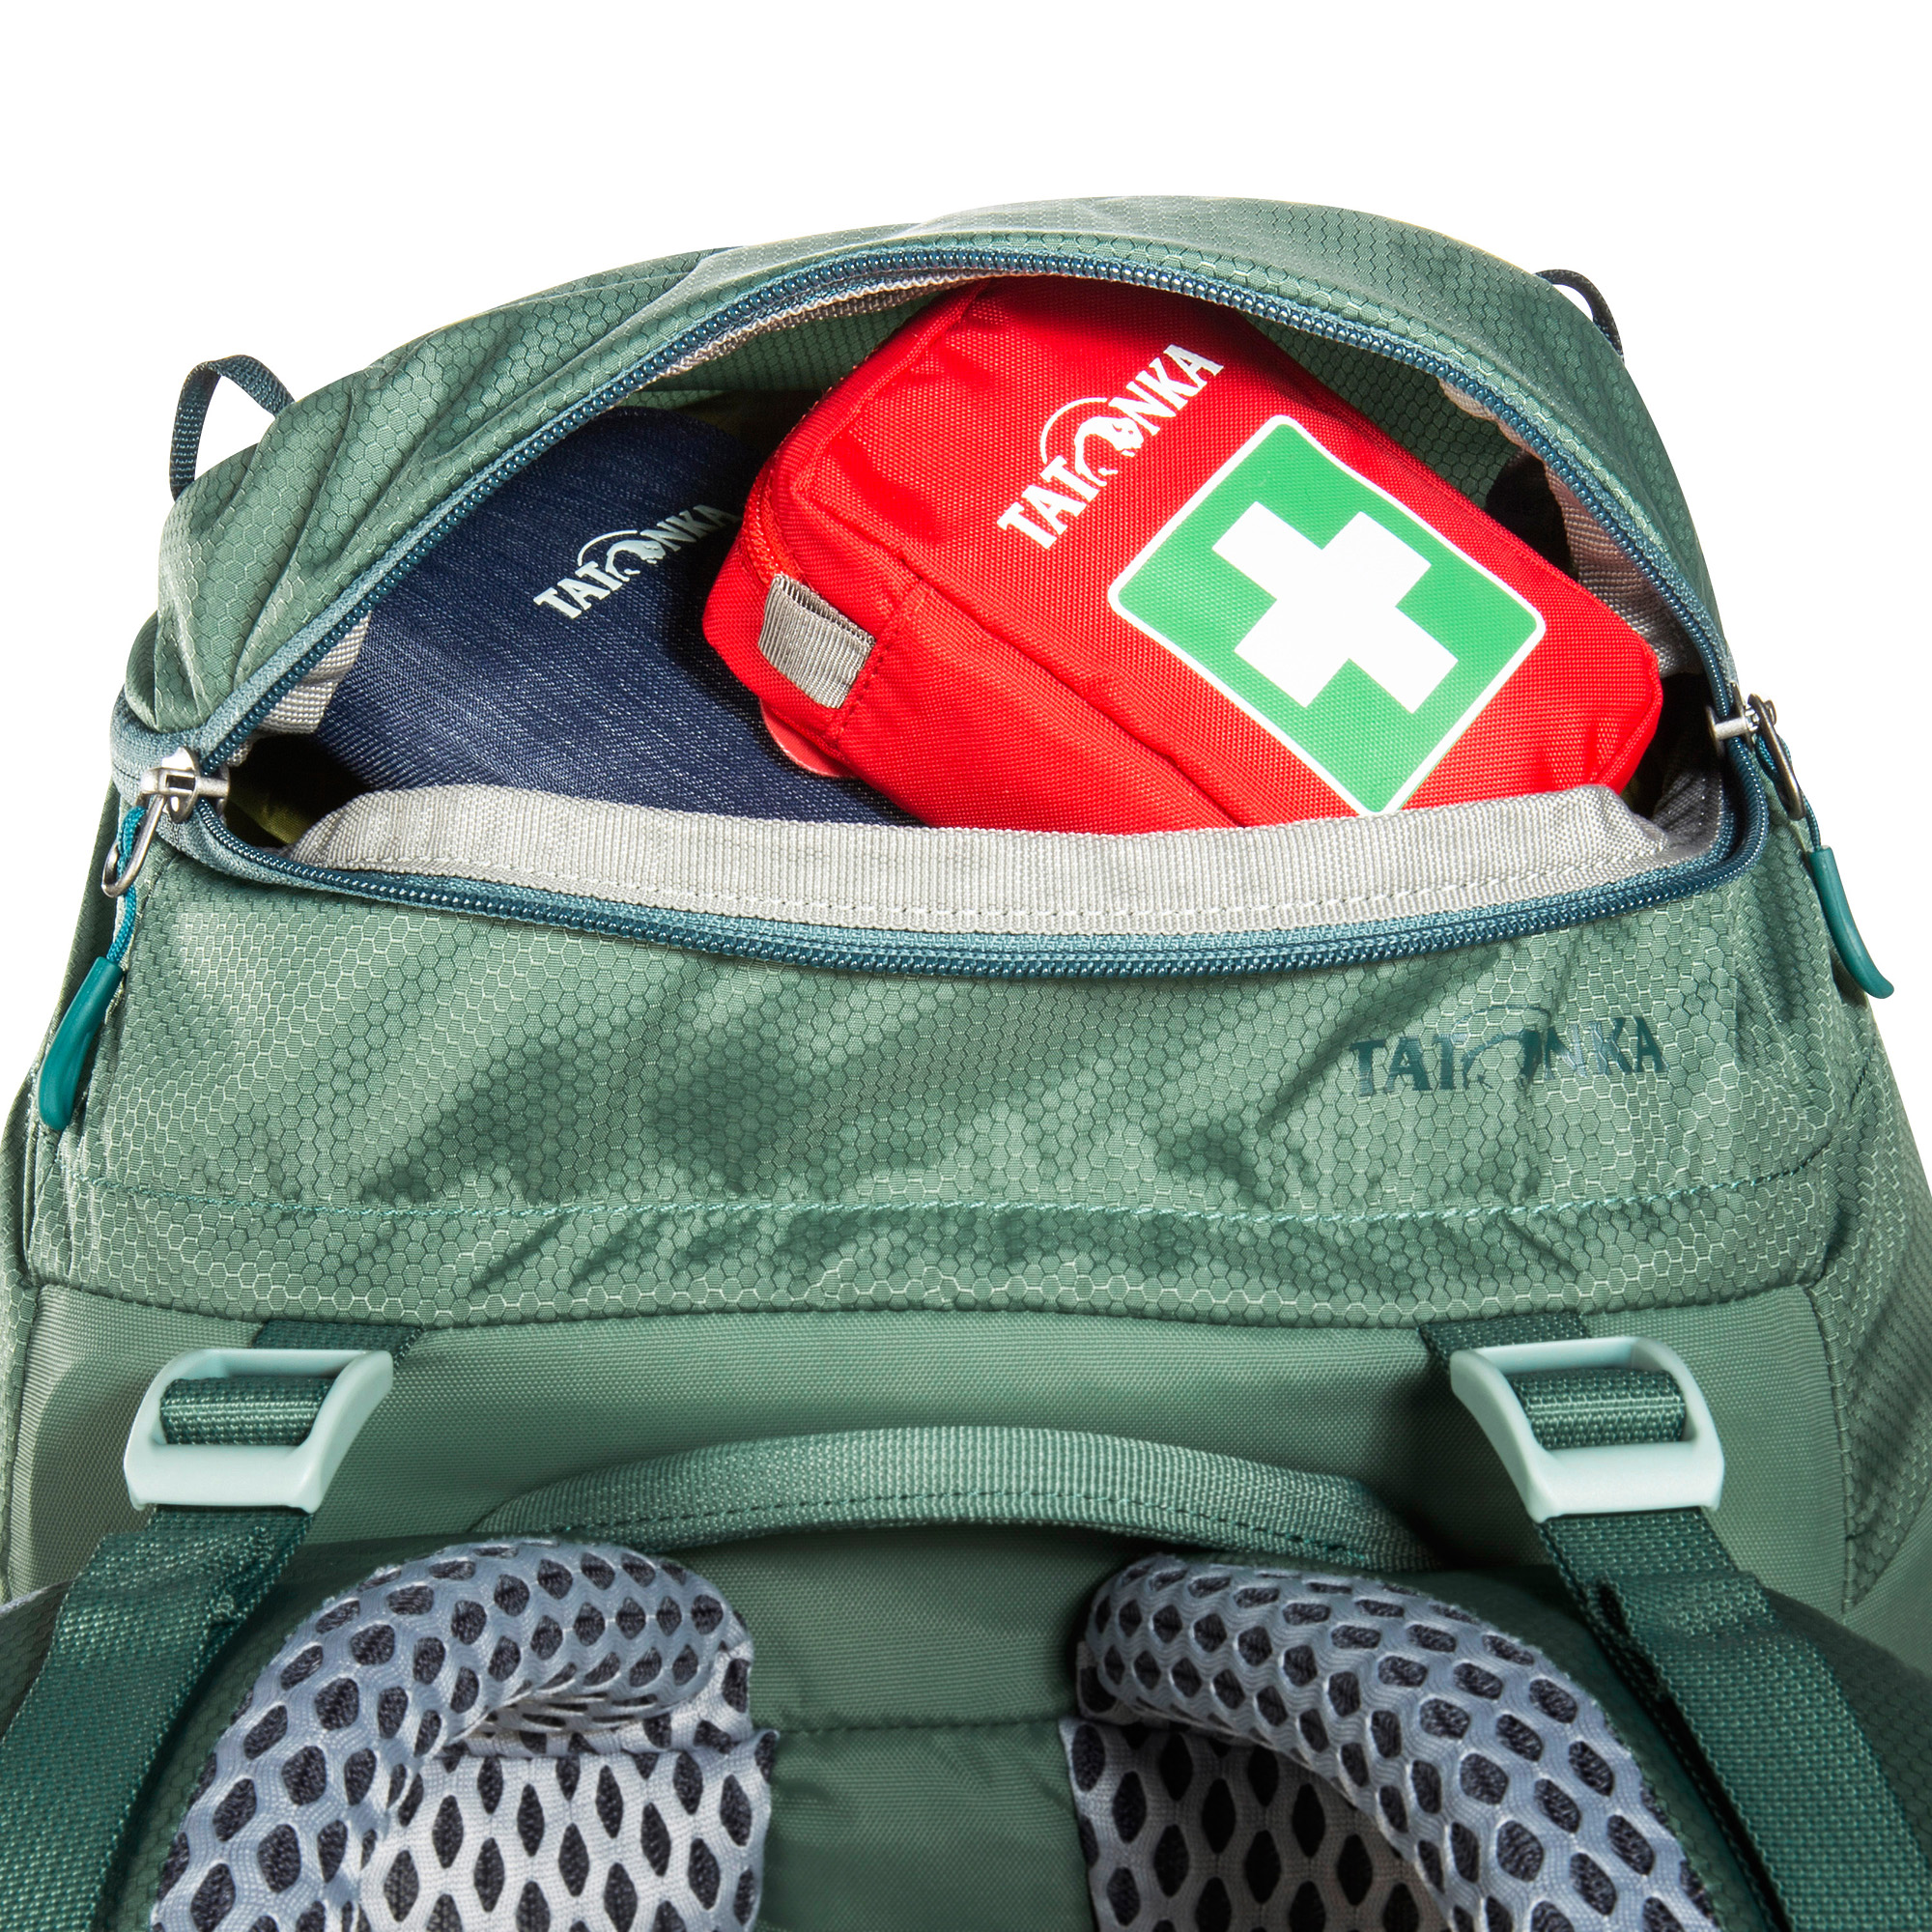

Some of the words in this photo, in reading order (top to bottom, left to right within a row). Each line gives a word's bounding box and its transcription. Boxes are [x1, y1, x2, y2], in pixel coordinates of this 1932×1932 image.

[997, 344, 1224, 549] TATONKA
[532, 504, 743, 619] TATONKA
[1350, 1006, 1669, 1096] TATONKA
